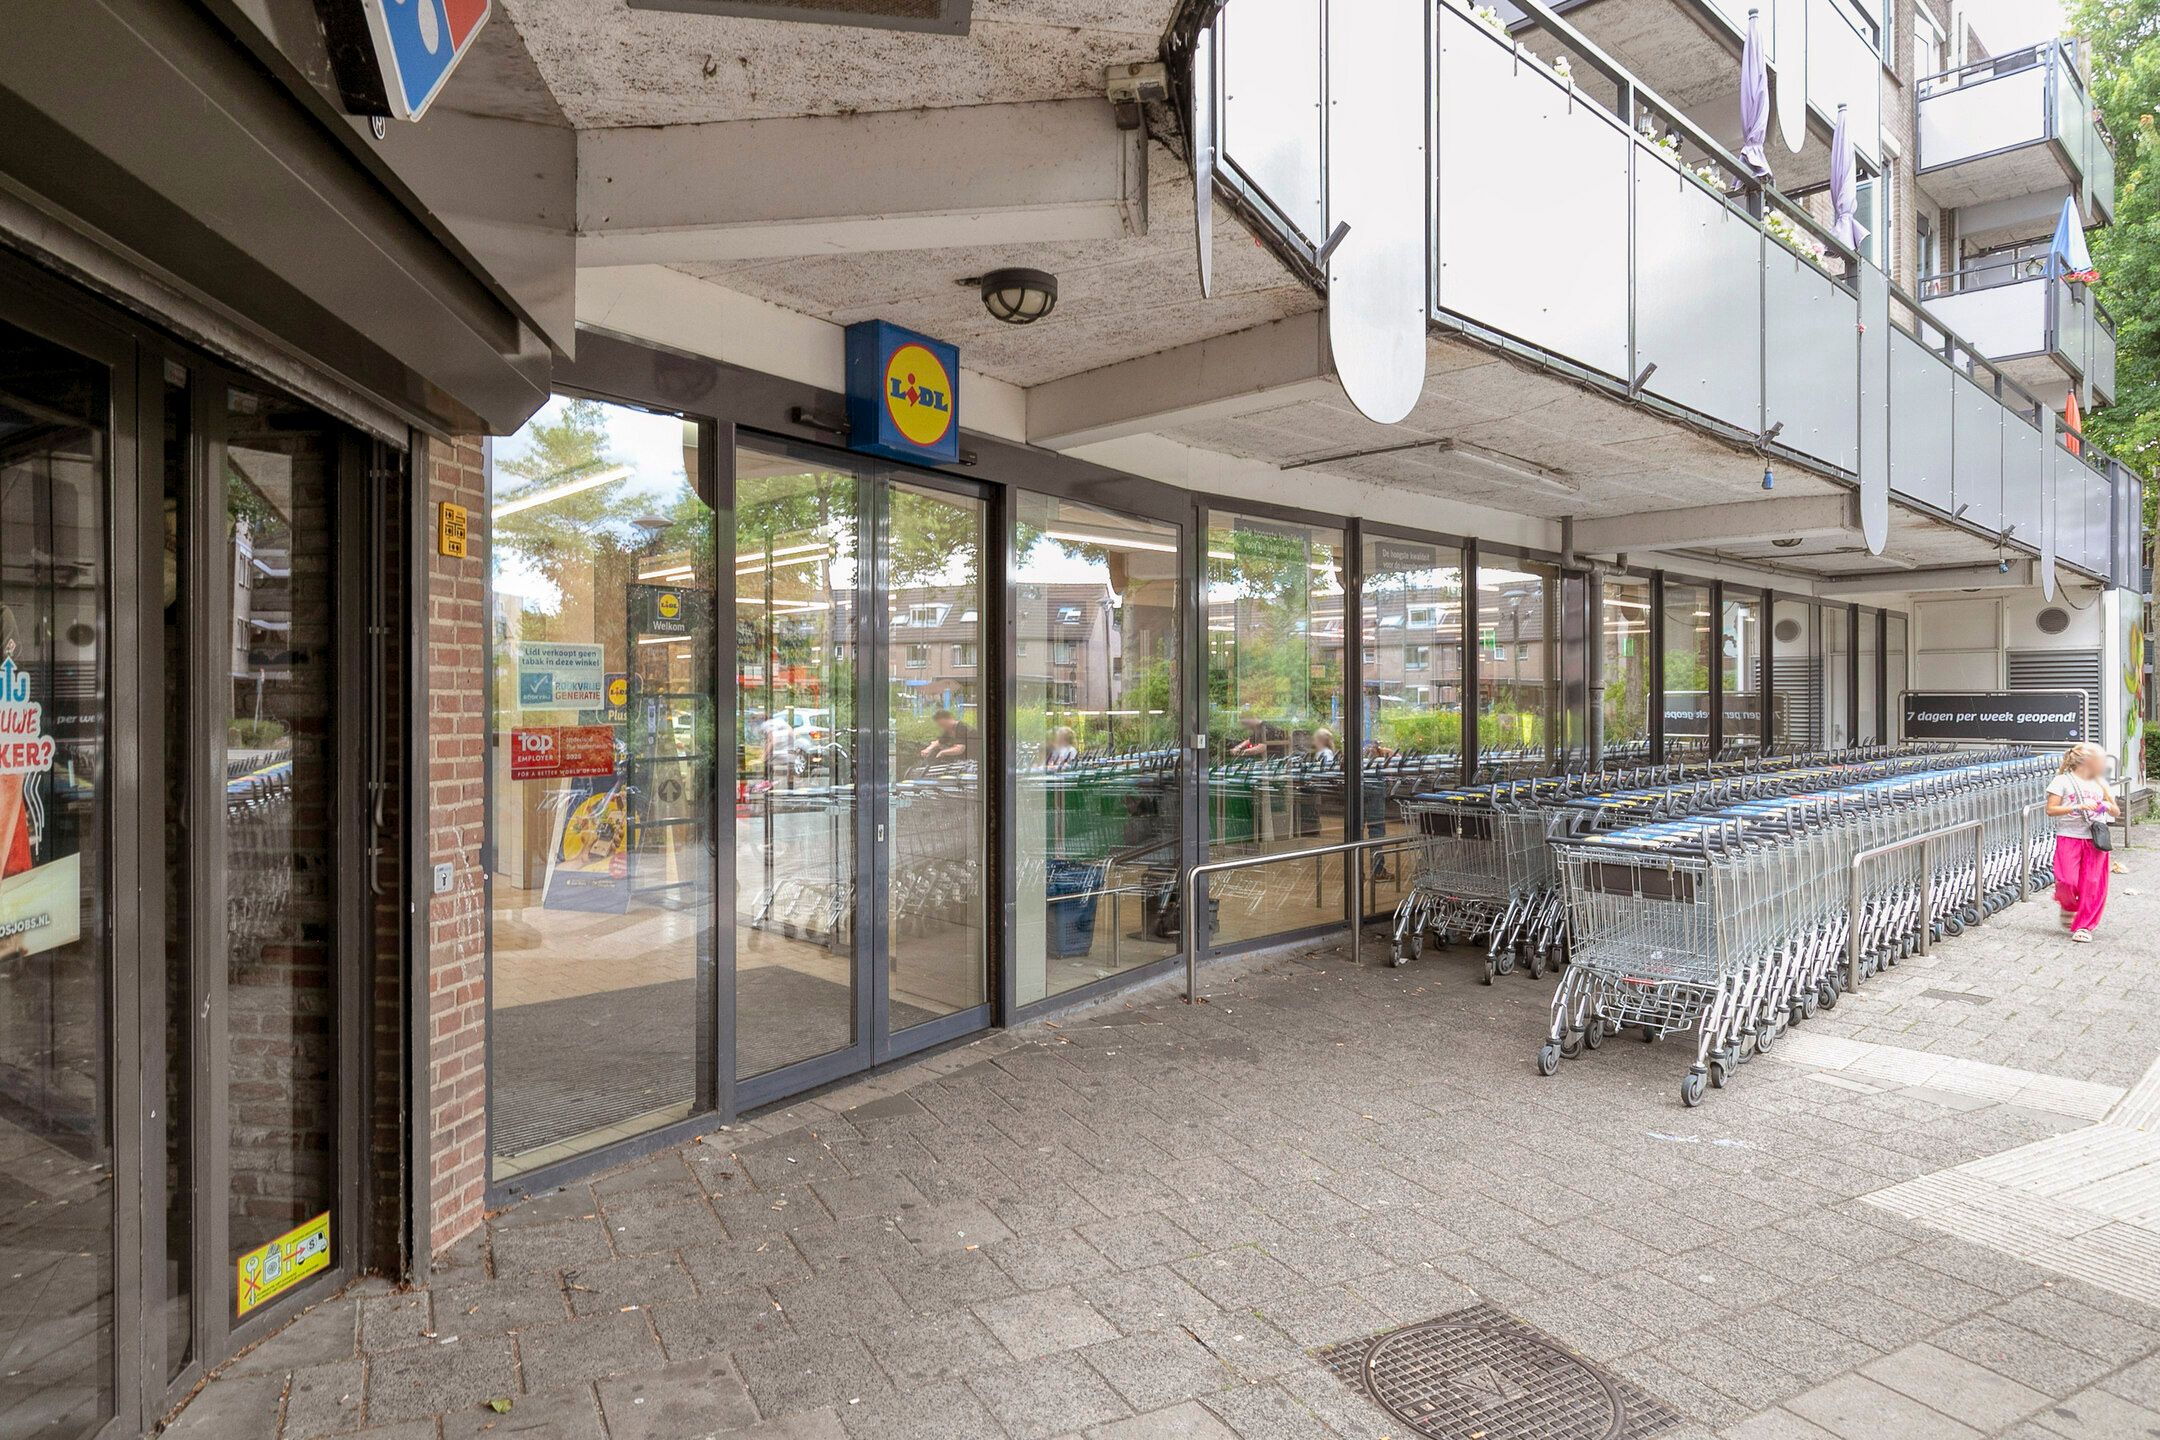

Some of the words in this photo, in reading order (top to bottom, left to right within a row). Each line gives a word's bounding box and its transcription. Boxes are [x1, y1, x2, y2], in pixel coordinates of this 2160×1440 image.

[653, 620, 685, 632] Welkom
[542, 649, 577, 658] verkoopt
[578, 651, 597, 659] geen
[555, 691, 601, 701] GENERATIE
[0, 708, 38, 735] UWE
[1907, 711, 1915, 721] 7
[1917, 711, 1953, 723] dagen
[1956, 712, 1977, 723] per
[1980, 711, 2014, 722] week
[2016, 712, 2077, 724] geopend!
[518, 732, 554, 754] top
[517, 754, 554, 762] EMPLOYER
